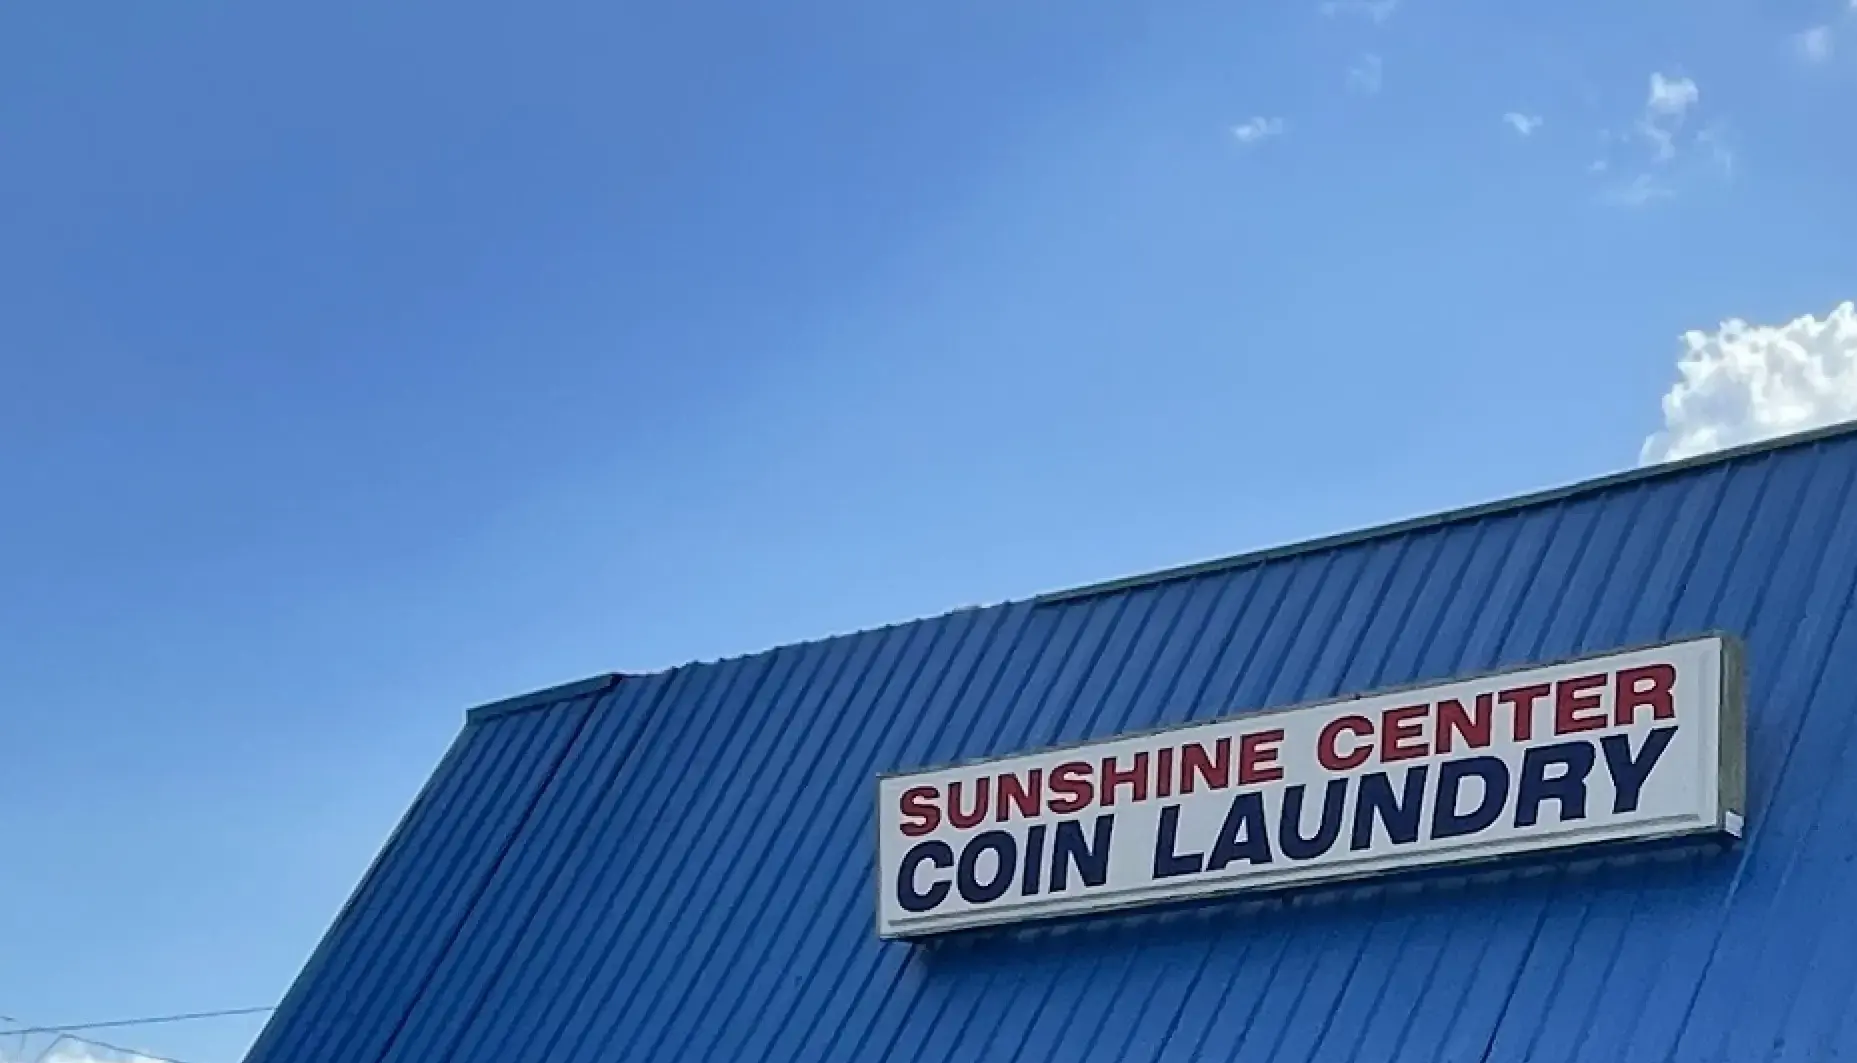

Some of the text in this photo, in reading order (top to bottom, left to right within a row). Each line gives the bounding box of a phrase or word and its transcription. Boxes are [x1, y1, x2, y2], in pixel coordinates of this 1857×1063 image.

[896, 726, 1680, 914] COIN LAUNDRY
[898, 663, 1678, 840] SUNSHINE CENTER
